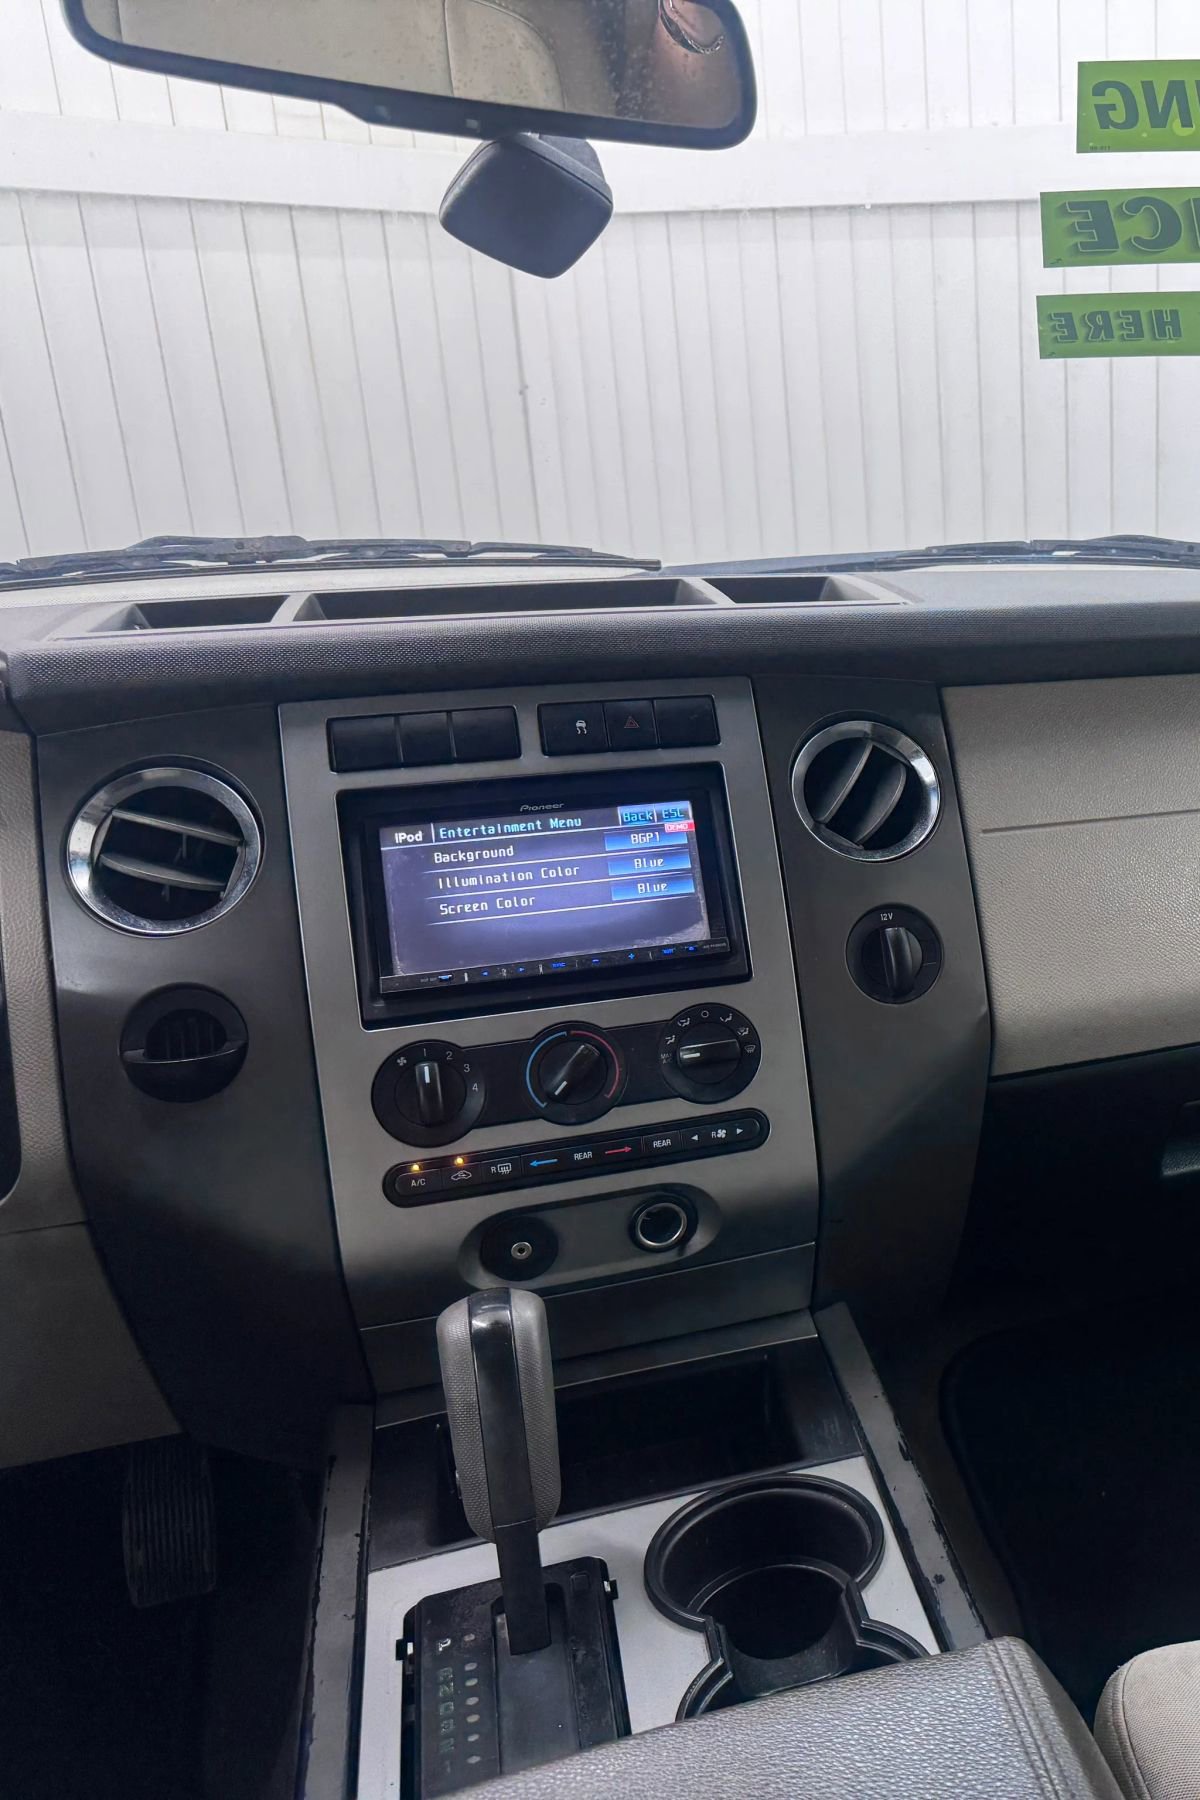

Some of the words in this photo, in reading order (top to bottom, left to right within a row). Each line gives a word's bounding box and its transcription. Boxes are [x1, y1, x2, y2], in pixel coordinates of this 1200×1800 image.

[520, 803, 565, 812] Pioneer
[622, 811, 653, 822] Back
[439, 819, 542, 839] Entertainment
[549, 817, 582, 829] Menu
[434, 845, 514, 864] Background
[633, 858, 664, 869] Blue
[439, 870, 533, 890] Illumination
[541, 866, 580, 879] Color
[637, 881, 668, 894] Blue
[439, 902, 488, 916] Screen
[496, 896, 536, 909] Color
[446, 1051, 453, 1060] 2
[463, 1063, 471, 1073] 3
[472, 1083, 479, 1092] 4
[653, 1138, 672, 1148] REAR
[574, 1151, 593, 1161] REAR
[411, 1178, 426, 1187] A/C
